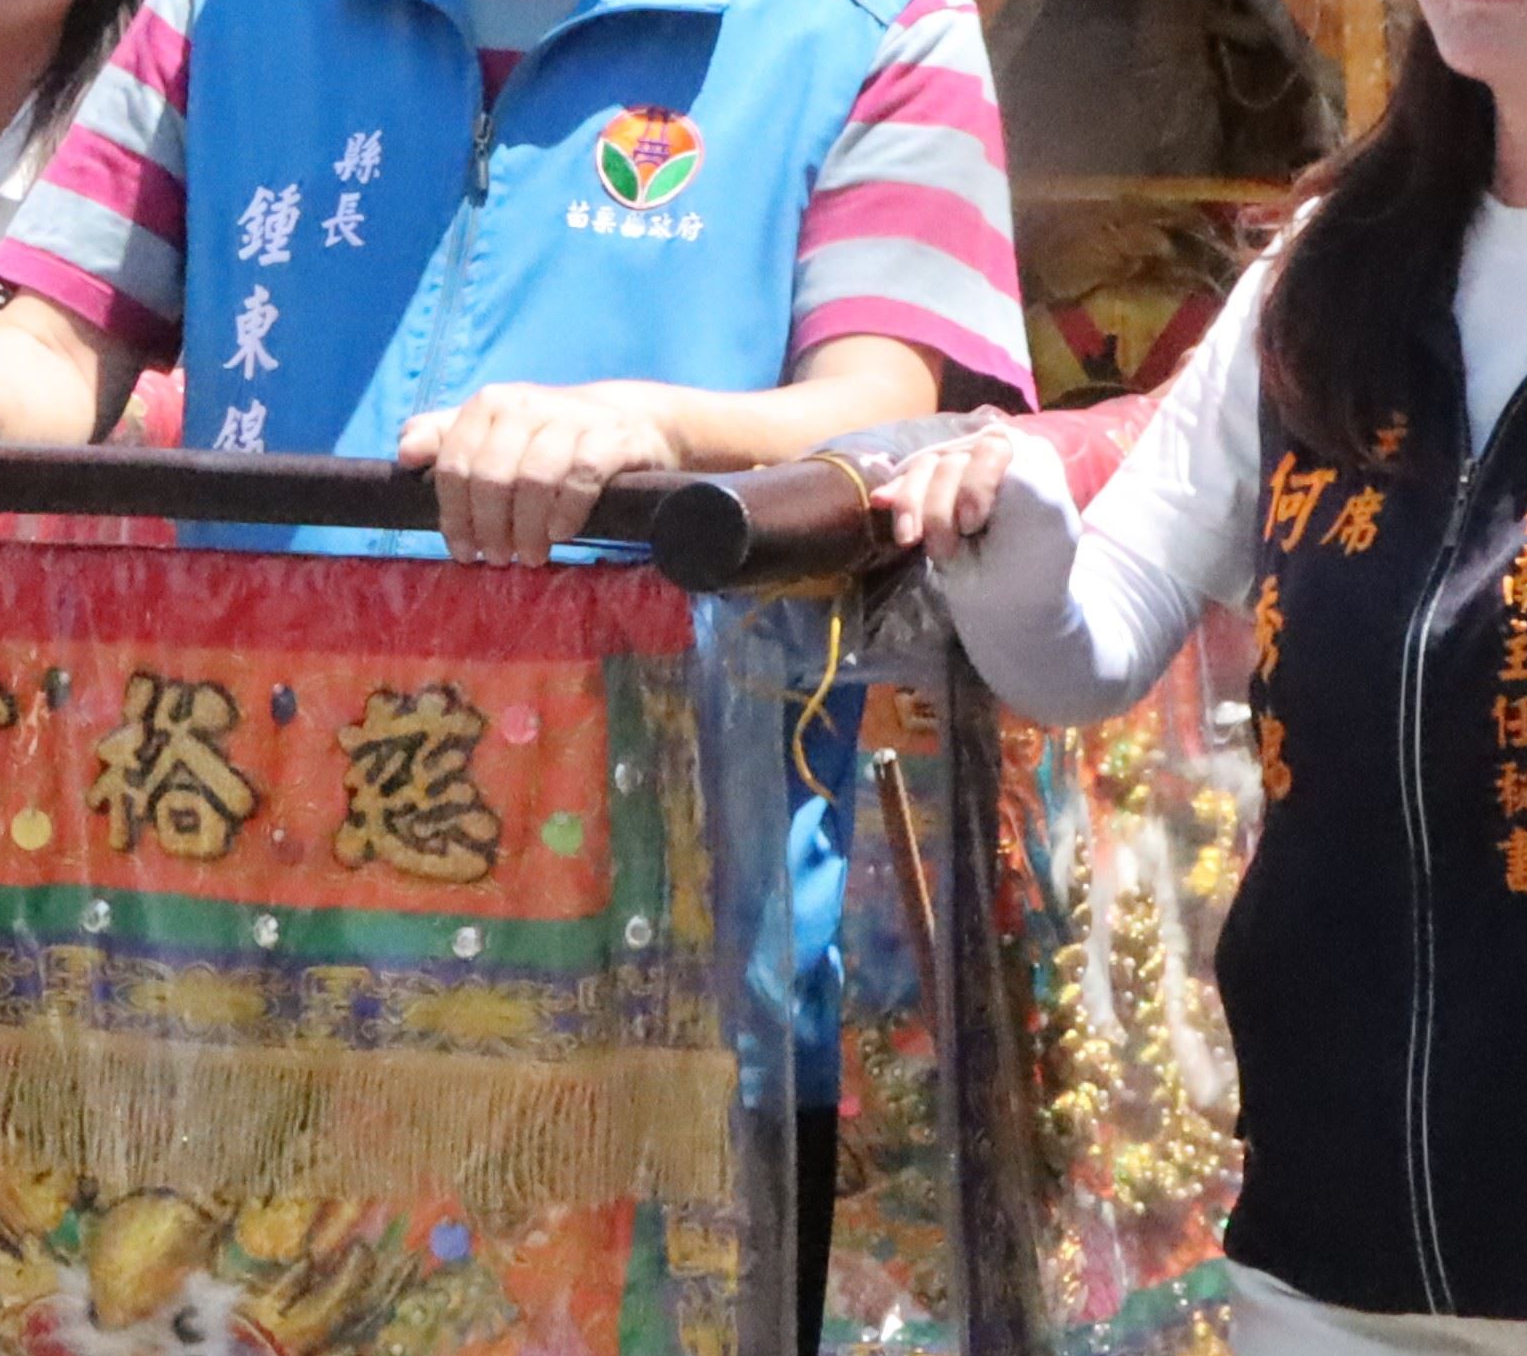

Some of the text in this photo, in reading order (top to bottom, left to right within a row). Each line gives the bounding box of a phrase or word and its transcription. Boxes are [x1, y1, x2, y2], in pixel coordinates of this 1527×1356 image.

[321, 129, 383, 249] 縣長
[565, 199, 705, 242] 苗栗縣政府
[212, 181, 302, 455] 鍾東錦
